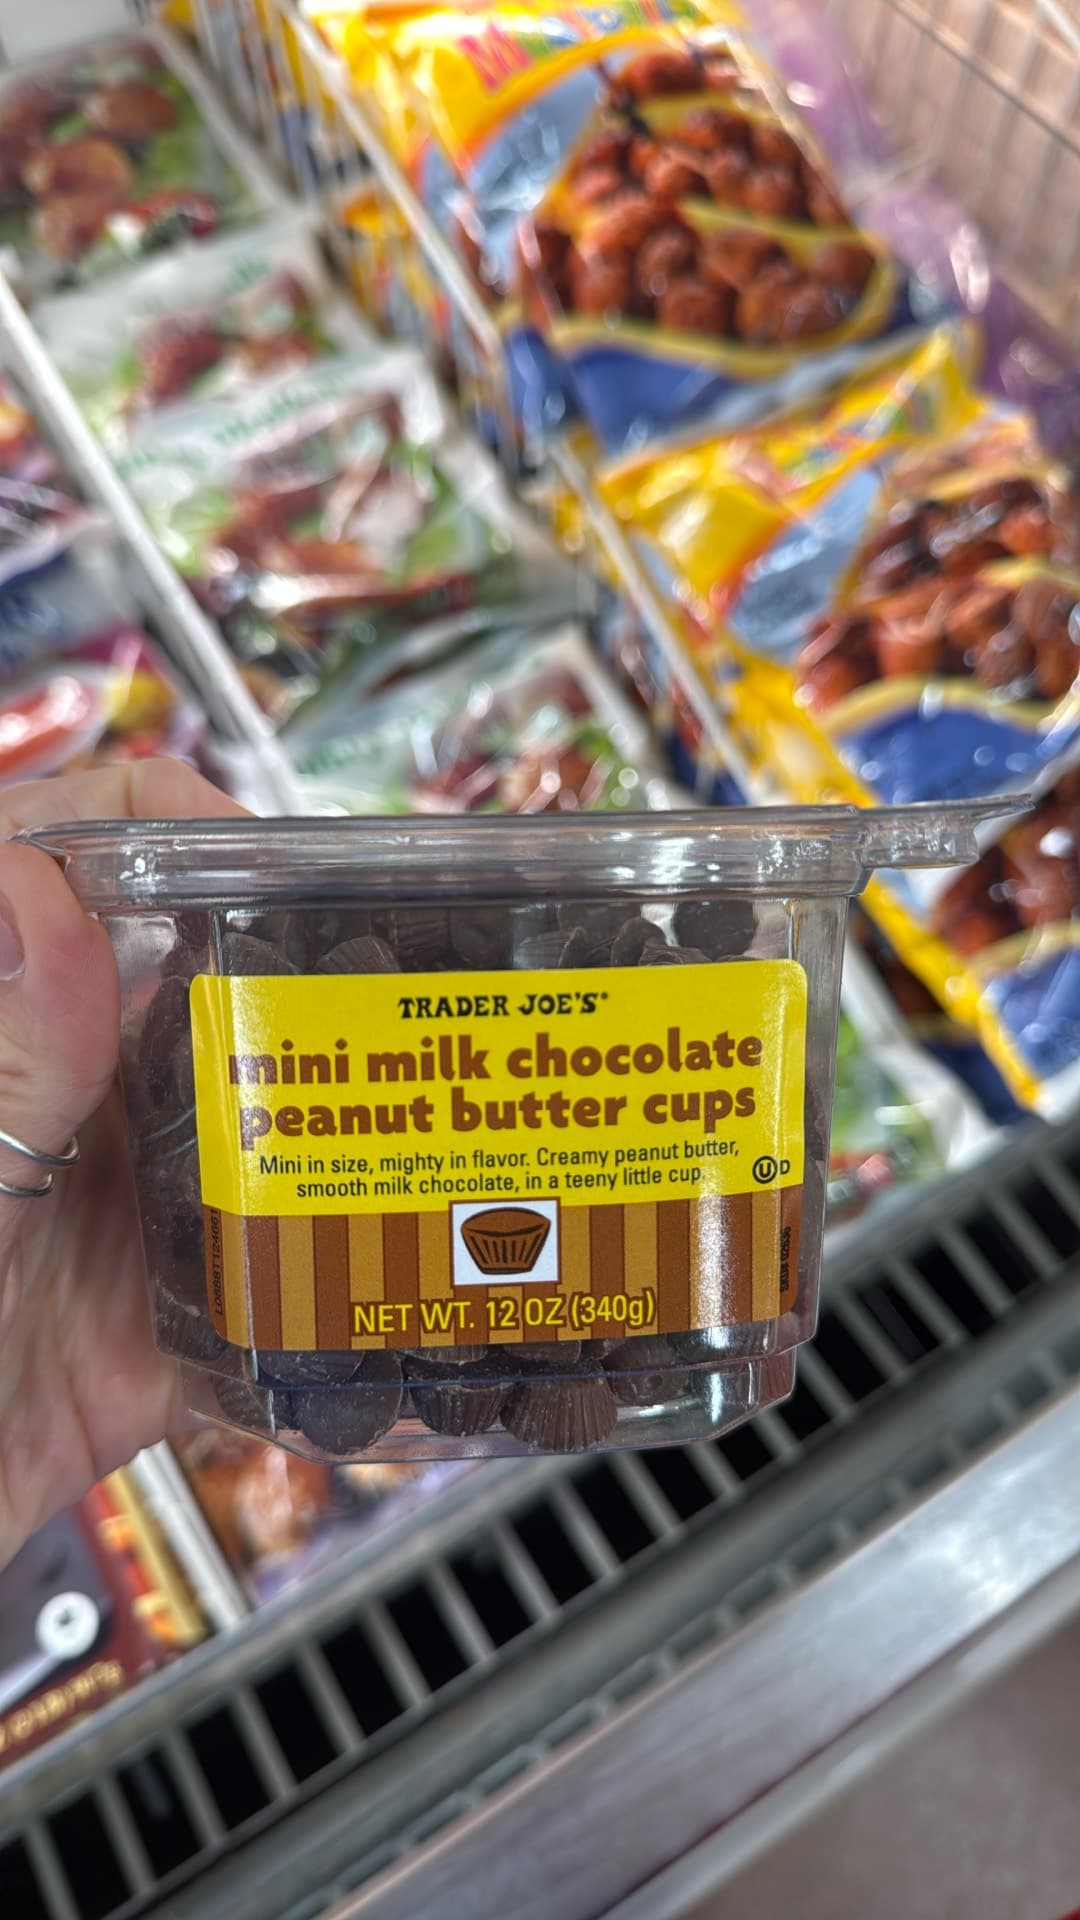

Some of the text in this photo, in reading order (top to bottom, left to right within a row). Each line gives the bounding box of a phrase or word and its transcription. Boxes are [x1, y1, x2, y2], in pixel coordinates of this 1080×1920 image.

[398, 995, 510, 1018] TRADER
[229, 1027, 763, 1085] mini milk chocolate
[239, 1086, 757, 1151] peanut butter cups
[259, 1137, 740, 1176] Mini in size, mighty in flavor. Creamy peanut butter,
[296, 1176, 368, 1198] smooth
[374, 1174, 413, 1196] milk
[419, 1171, 520, 1195] chocolate,
[525, 1170, 542, 1190] in
[548, 1173, 559, 1189] a
[565, 1168, 617, 1191] teeny
[623, 1164, 662, 1186] little
[353, 1291, 655, 1334] NET WT. 12 OZ (340g)
